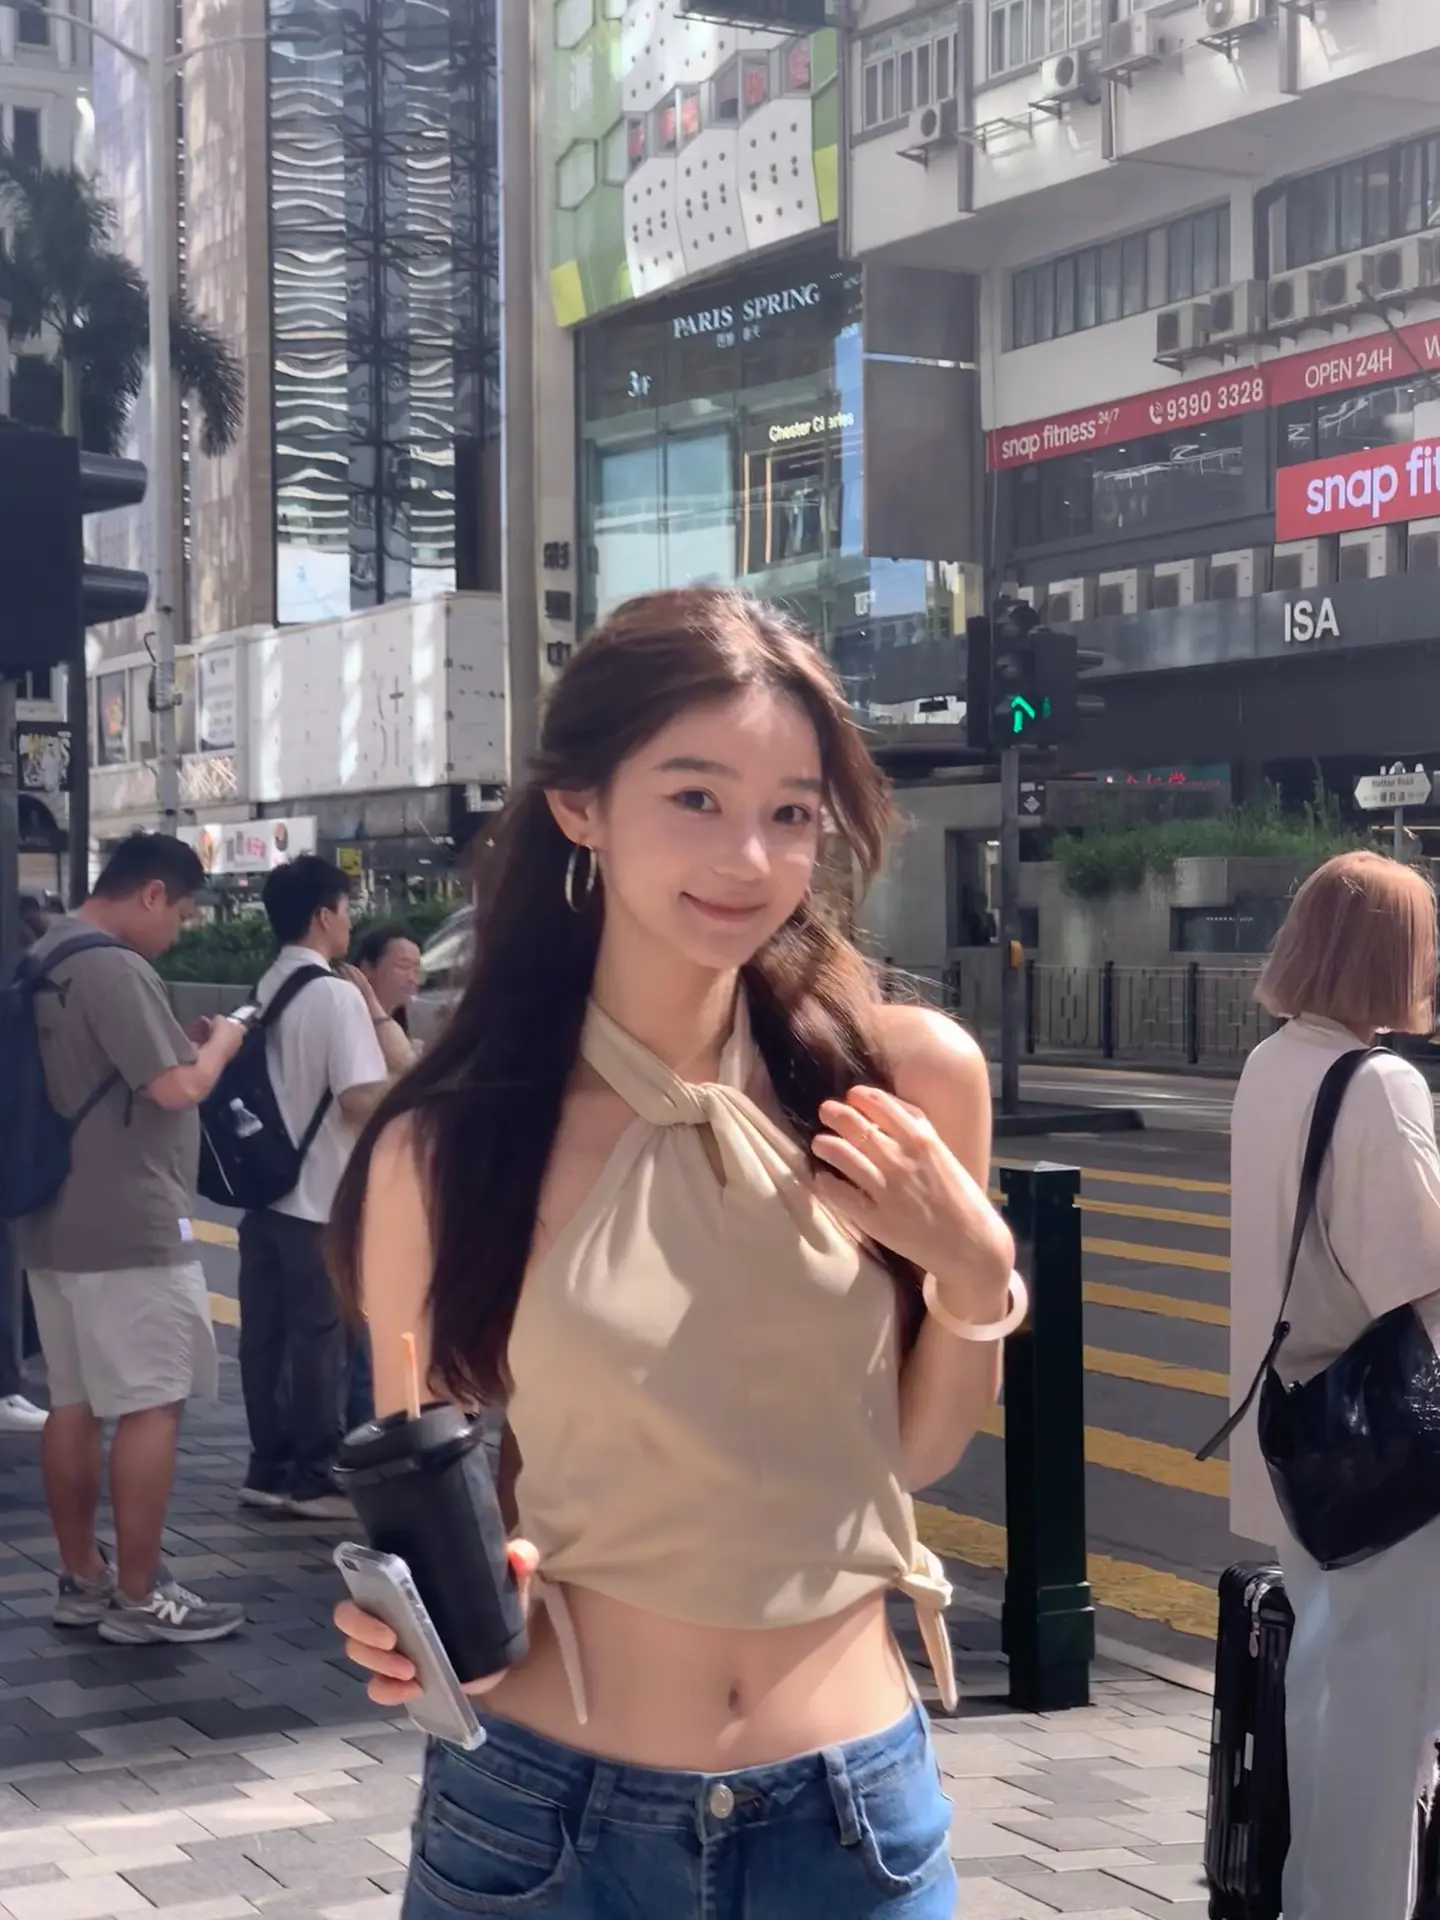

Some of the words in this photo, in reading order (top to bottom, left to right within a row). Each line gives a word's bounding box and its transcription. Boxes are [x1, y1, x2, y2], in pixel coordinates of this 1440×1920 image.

[672, 305, 734, 340] PARIS
[742, 282, 821, 323] SPRING
[1304, 359, 1353, 389] OPEN
[1355, 345, 1393, 378] 24H
[1166, 390, 1212, 422] 9390
[1217, 378, 1264, 410] 3328
[1001, 433, 1040, 460] snap
[1042, 419, 1097, 450] fitness
[1306, 463, 1399, 519] snap
[1283, 597, 1341, 643] ISA
